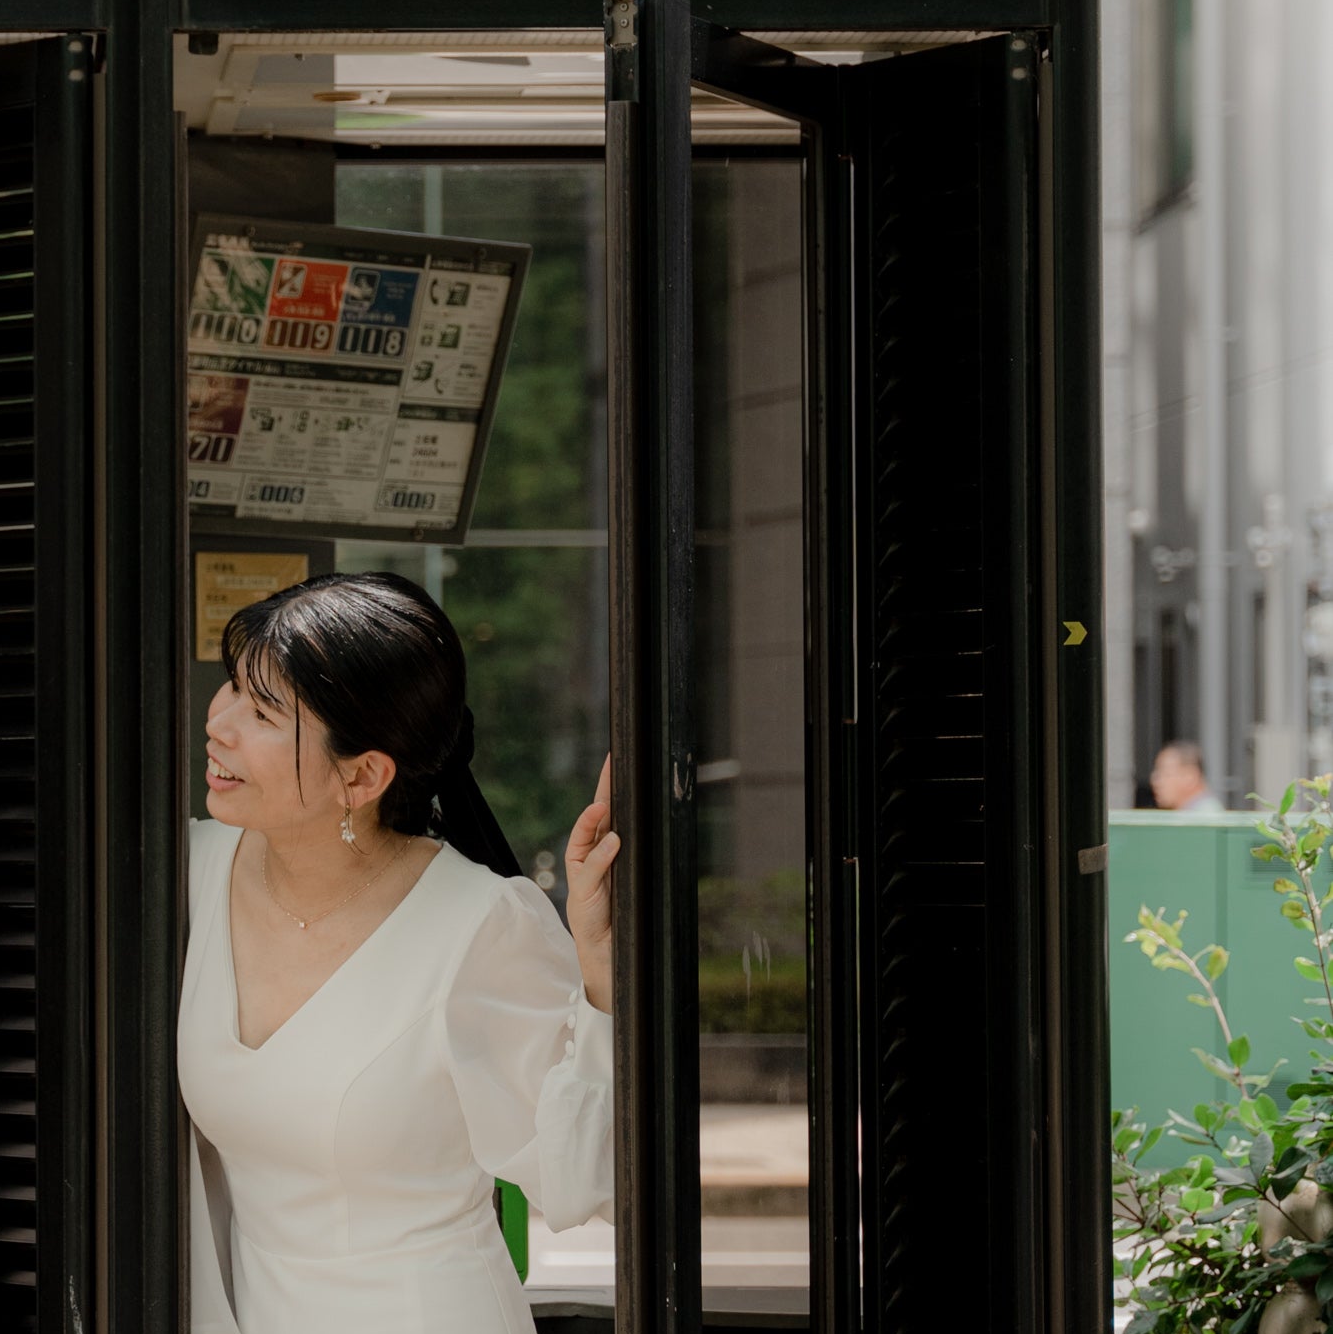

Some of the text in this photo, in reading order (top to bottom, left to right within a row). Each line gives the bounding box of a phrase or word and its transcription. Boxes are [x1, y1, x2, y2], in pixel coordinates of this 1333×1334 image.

[193, 313, 258, 343] 110
[271, 321, 332, 349] 119
[343, 326, 403, 354] 118
[190, 436, 233, 462] 71
